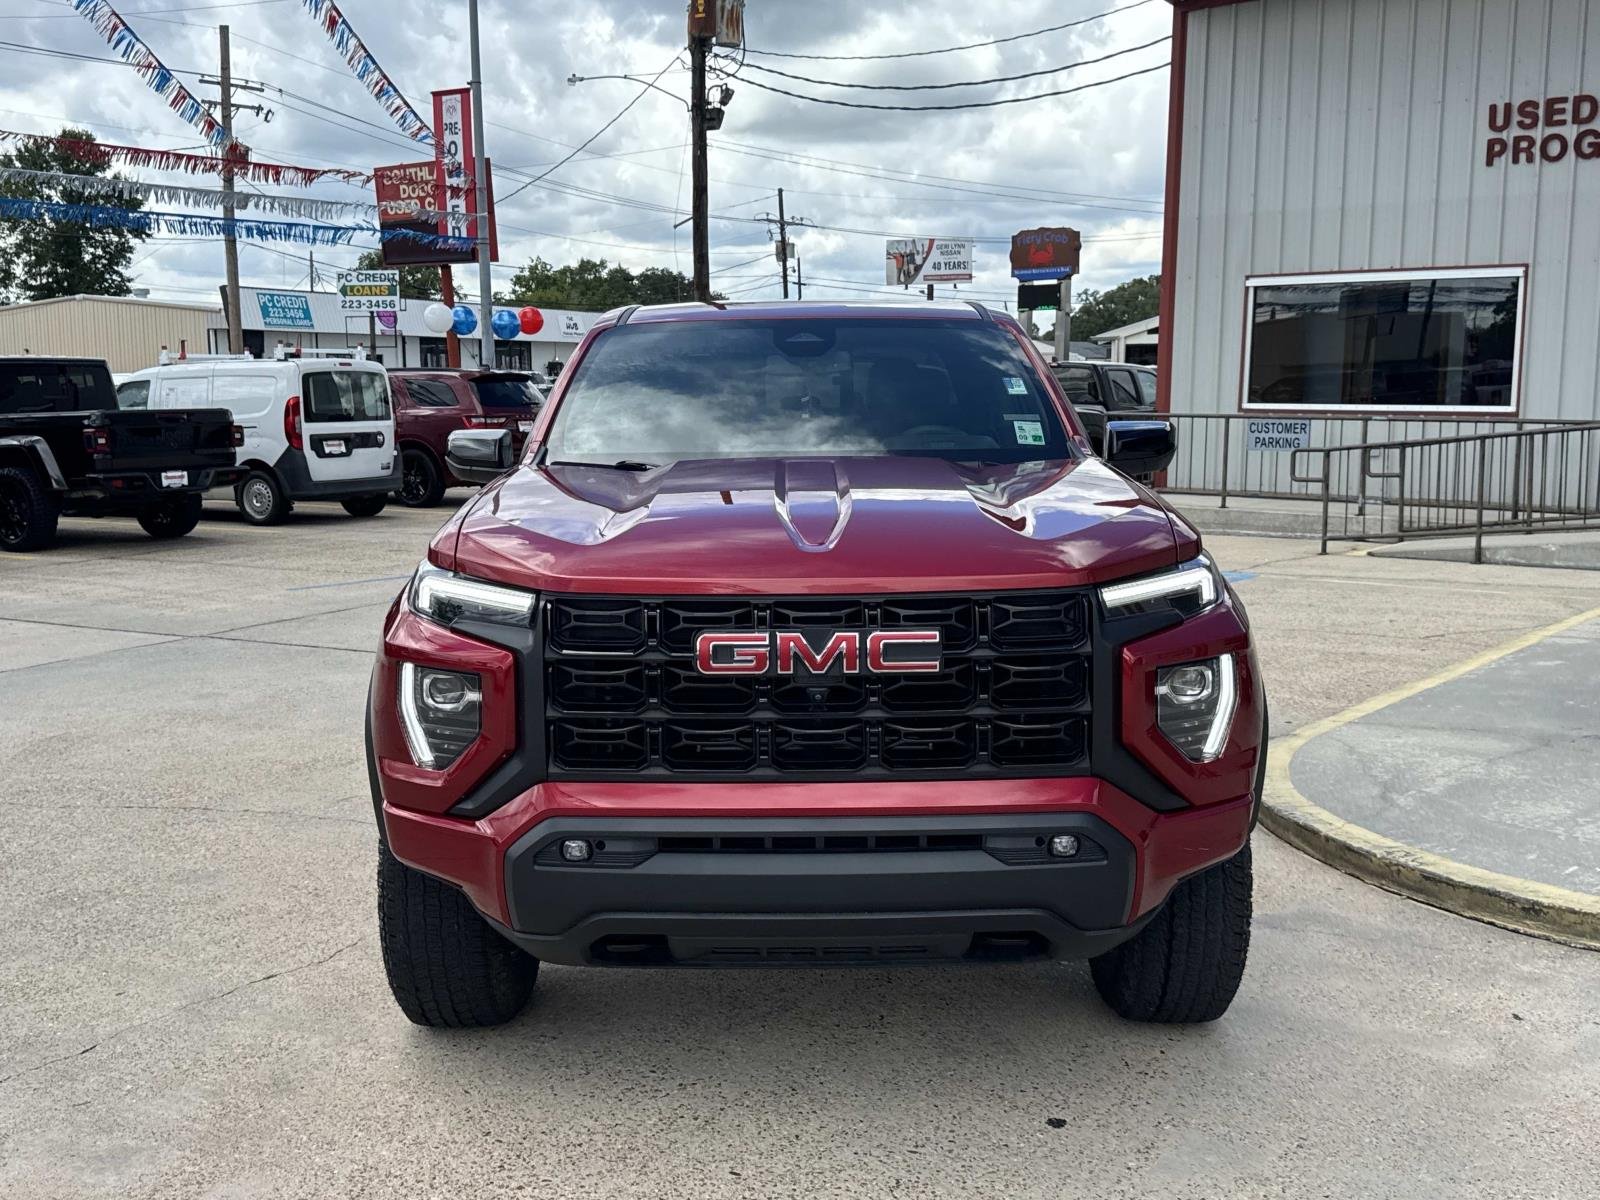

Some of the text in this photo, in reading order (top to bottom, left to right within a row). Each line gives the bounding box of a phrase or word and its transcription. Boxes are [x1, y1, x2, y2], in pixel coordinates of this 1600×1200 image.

[1488, 94, 1598, 133] USED
[932, 260, 969, 270] 40 YEARS!
[337, 272, 398, 283] PC CREDIT
[346, 285, 389, 296] LOANS
[258, 294, 307, 310] PC CREDIT
[341, 299, 396, 309] 223-3456
[268, 307, 305, 318] 223-3456
[1249, 422, 1307, 434] CUSTOMER
[1254, 437, 1301, 449] PARKING
[696, 631, 940, 674] GMC
